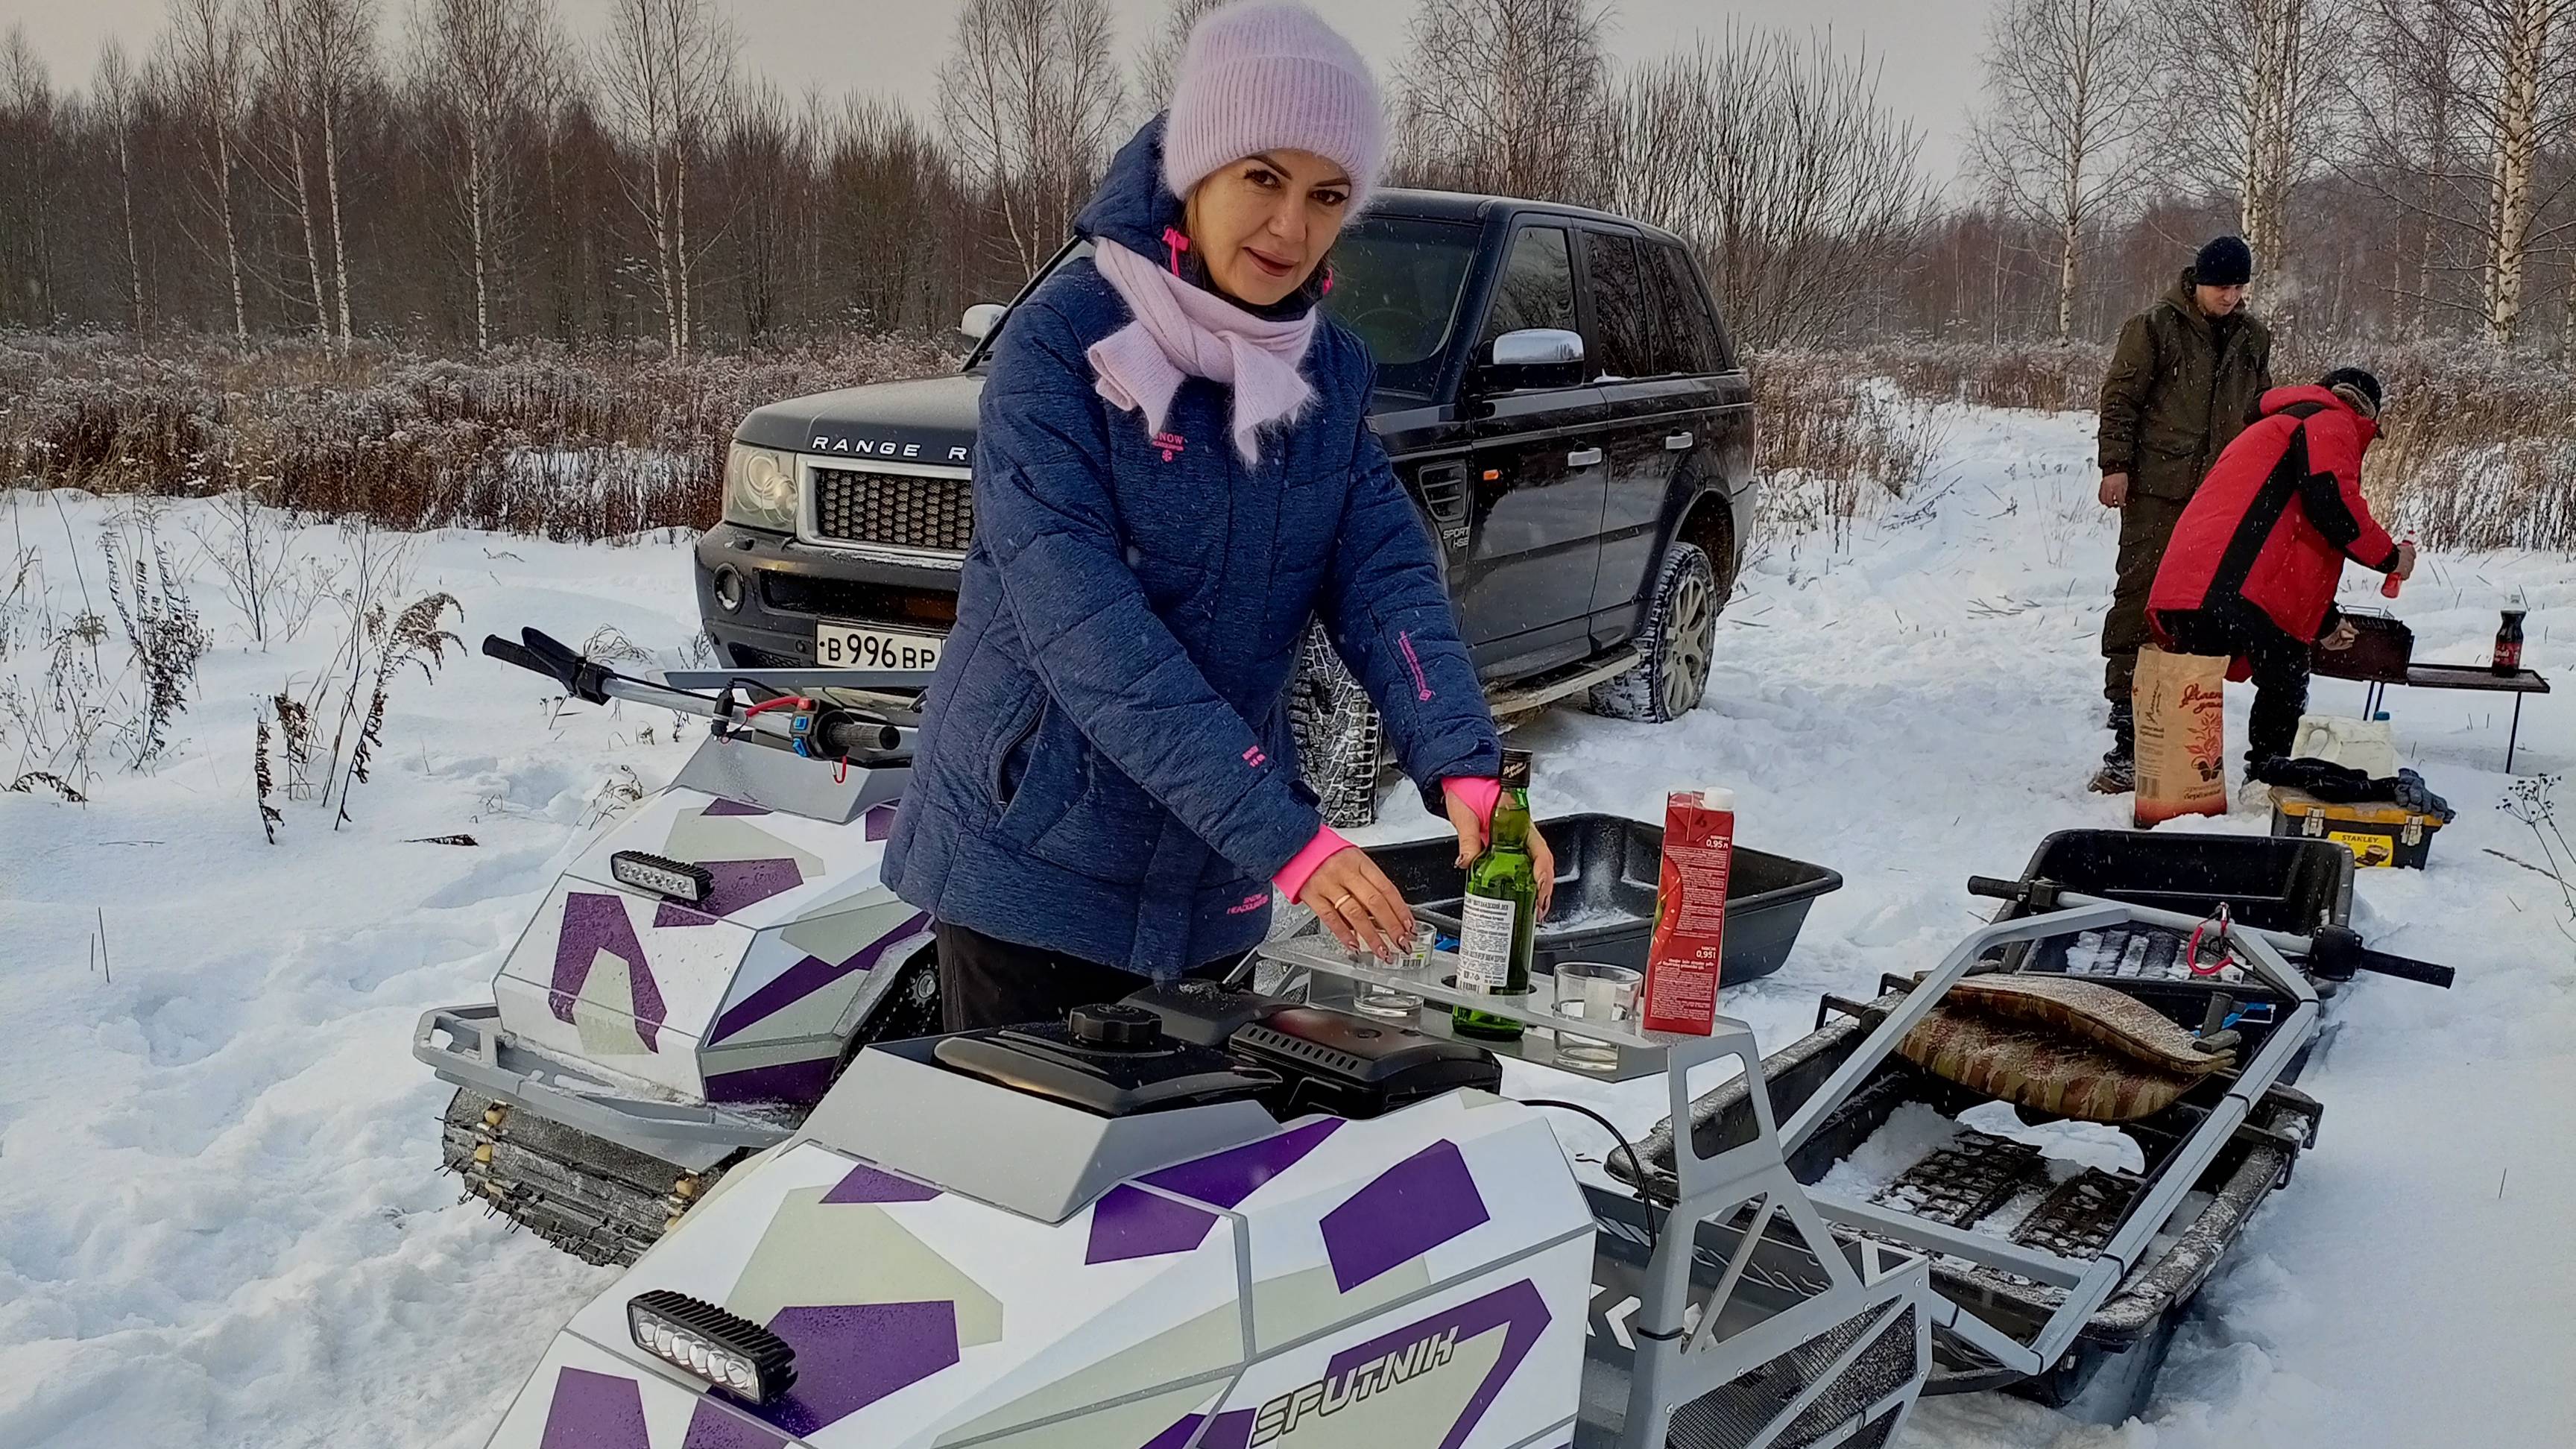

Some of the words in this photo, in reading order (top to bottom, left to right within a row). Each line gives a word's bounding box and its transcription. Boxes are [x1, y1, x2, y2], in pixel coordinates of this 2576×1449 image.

[812, 436, 921, 457] RANGE
[2342, 834, 2378, 843] STANLEY
[1250, 1325, 1460, 1448] SPUTNIK
